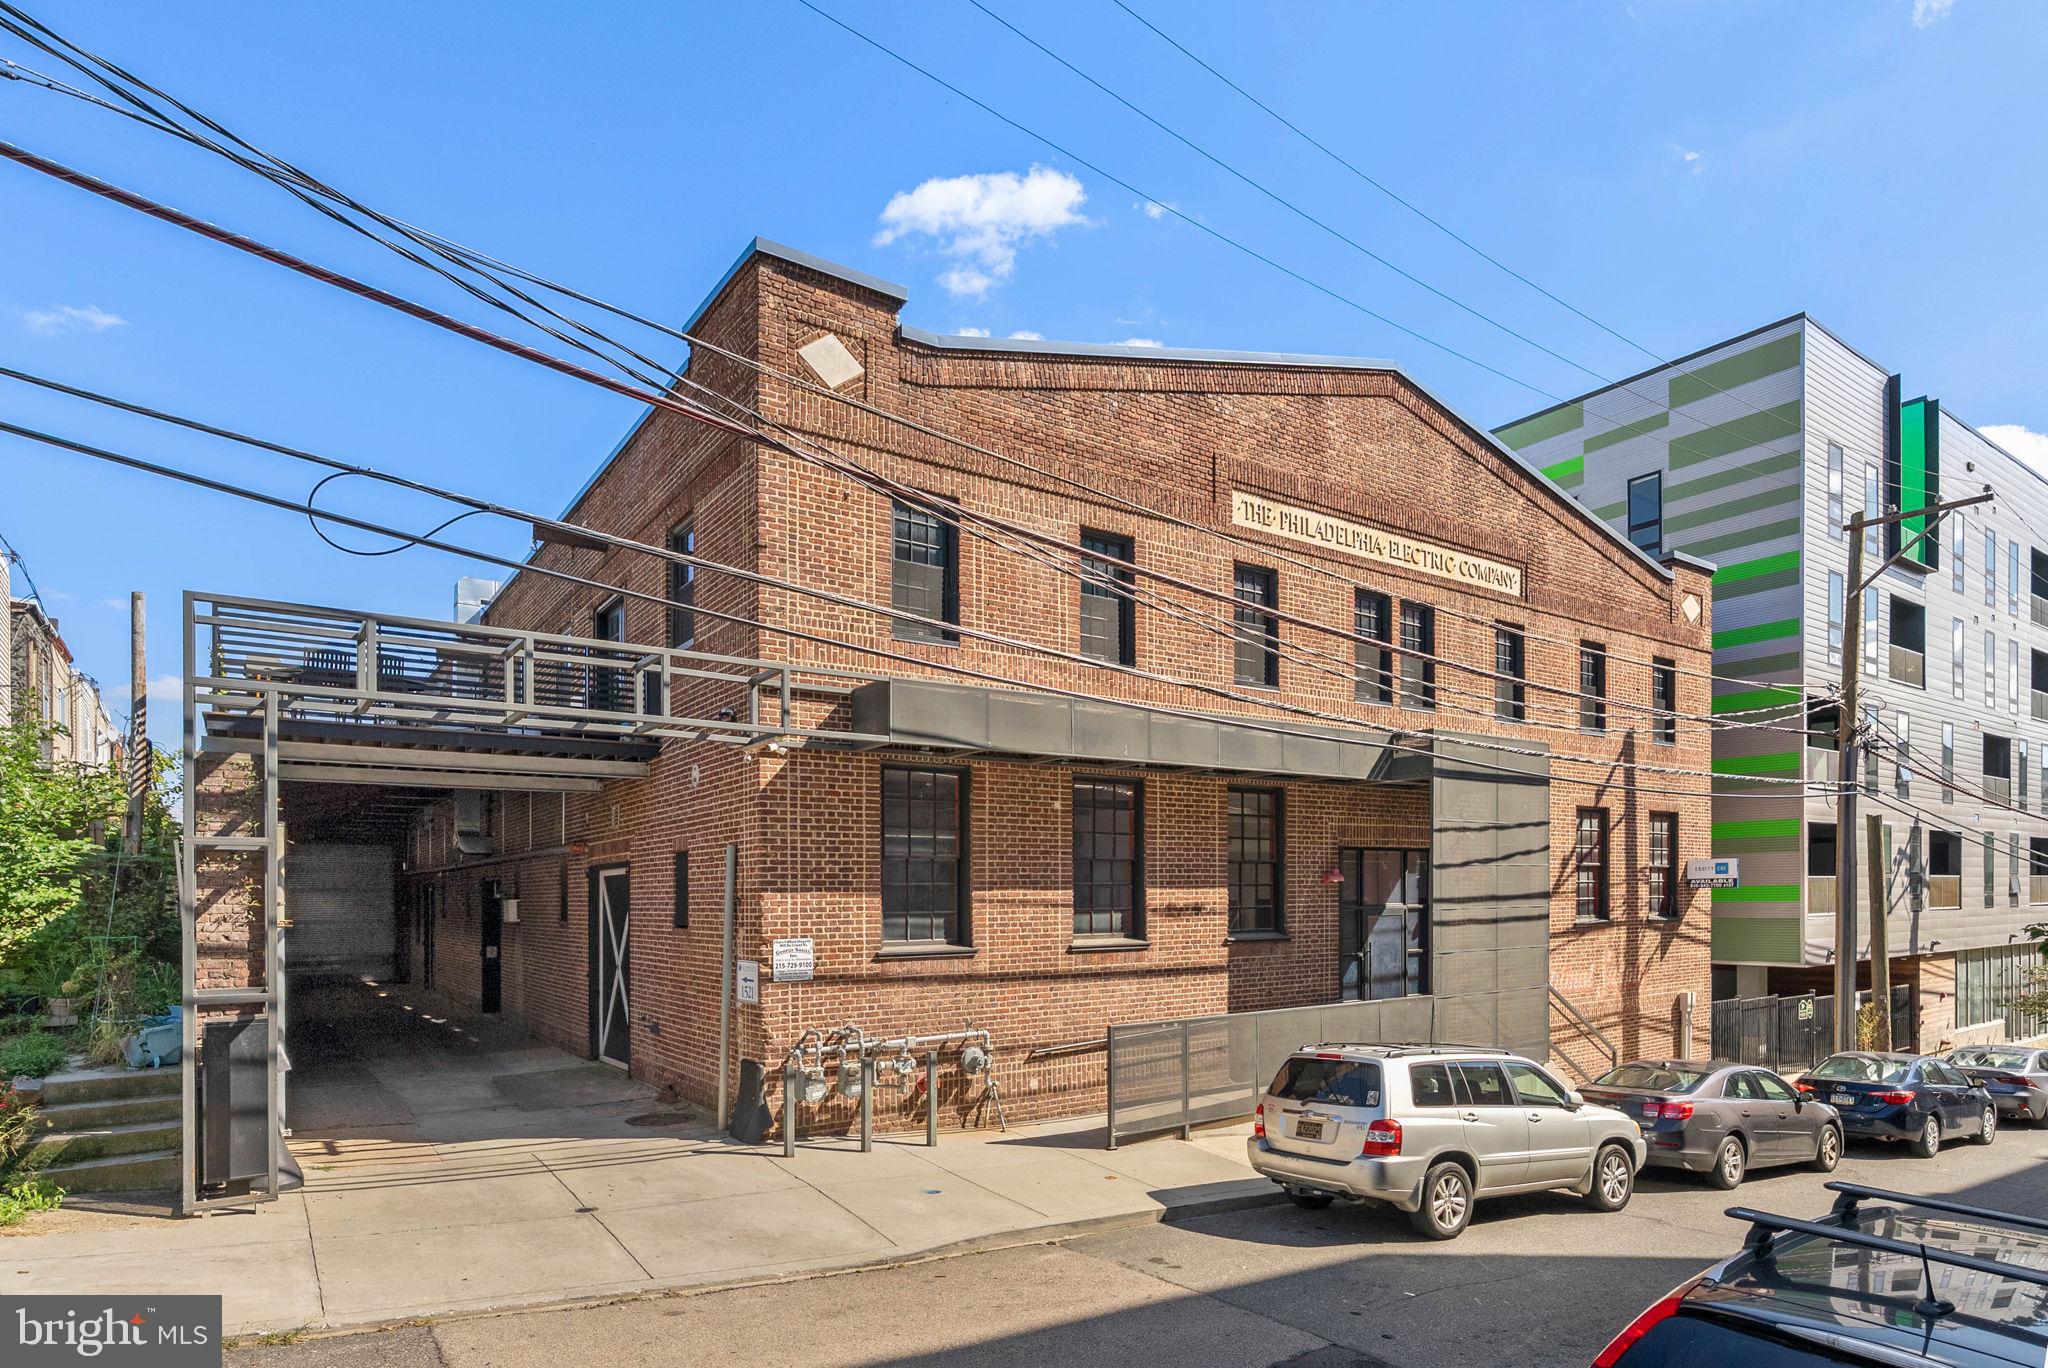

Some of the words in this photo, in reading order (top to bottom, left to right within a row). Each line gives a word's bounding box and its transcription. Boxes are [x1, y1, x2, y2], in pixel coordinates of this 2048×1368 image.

[1239, 499, 1274, 527] THE
[1279, 510, 1383, 556] PHILADELPHIA
[1388, 540, 1454, 574] ELECTRIC
[1459, 560, 1516, 590] COMPANY
[775, 961, 812, 970] 215-729-9100
